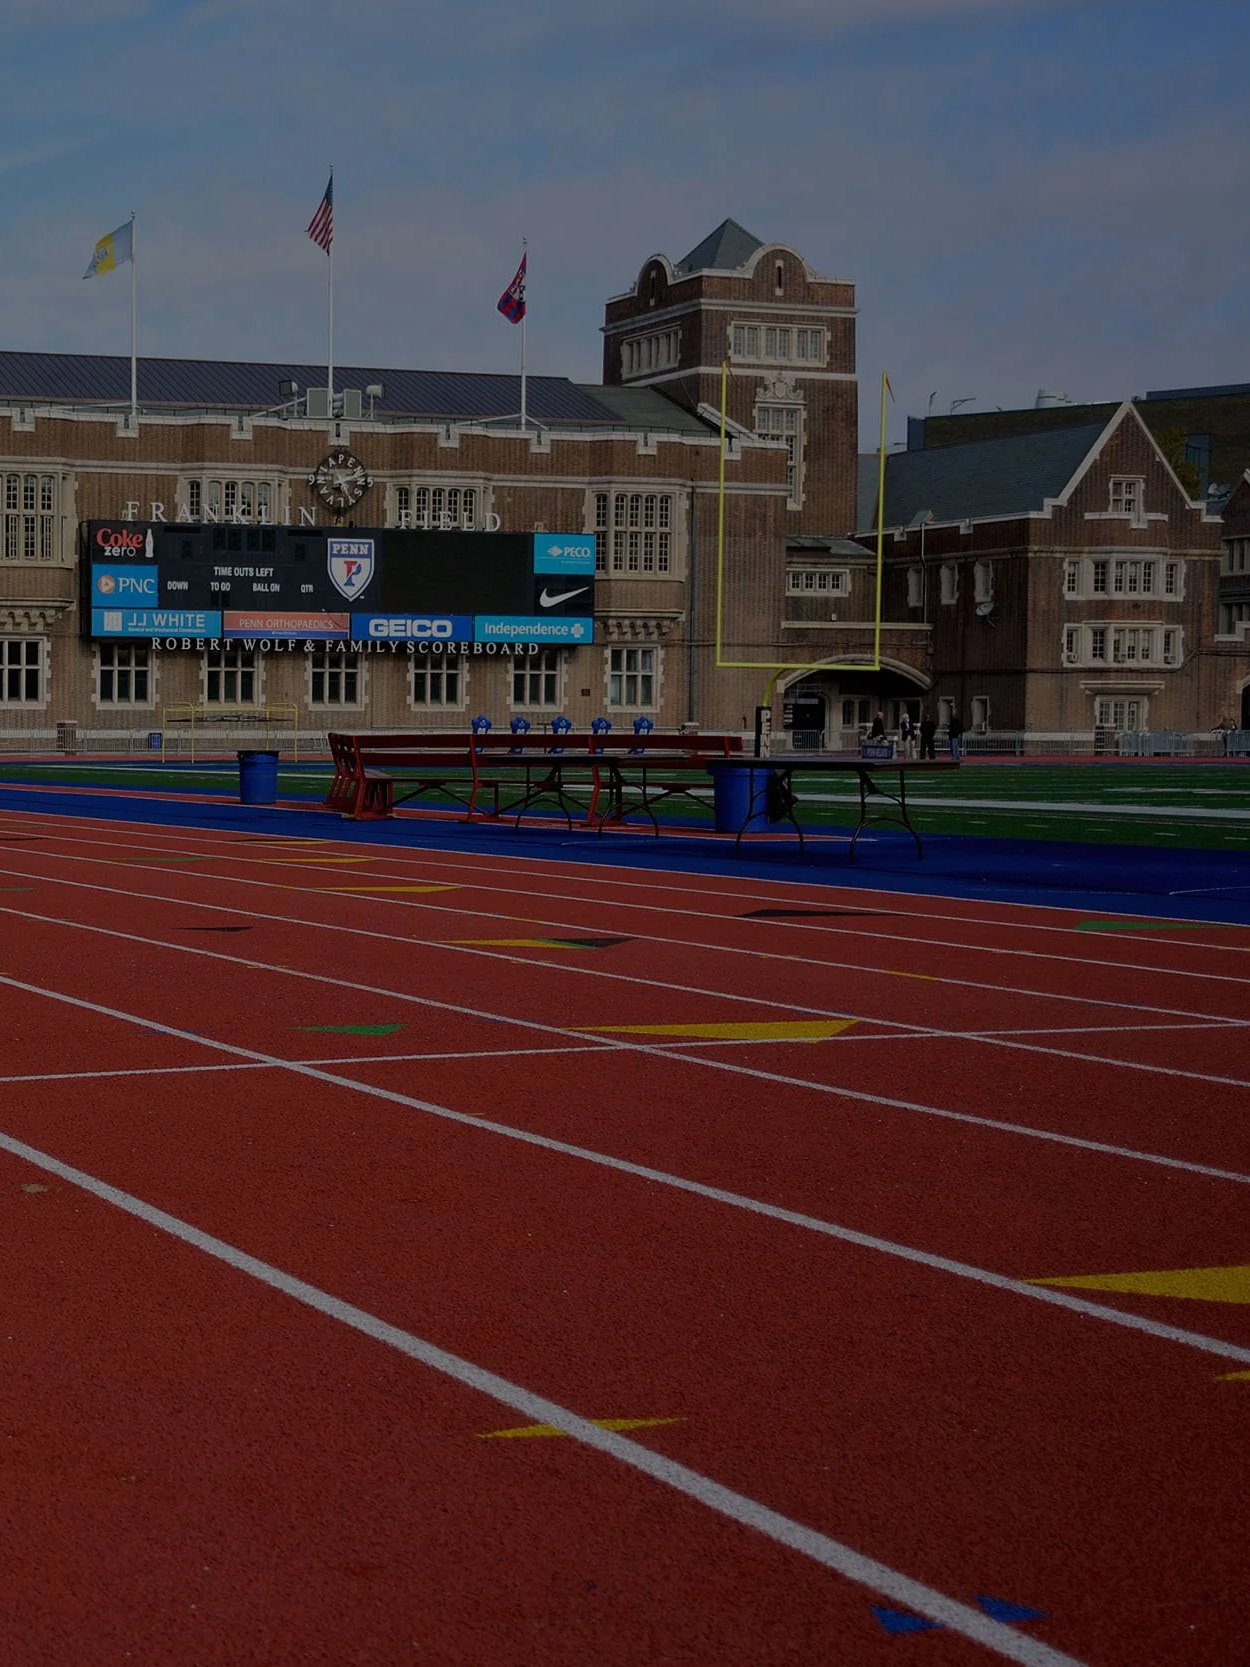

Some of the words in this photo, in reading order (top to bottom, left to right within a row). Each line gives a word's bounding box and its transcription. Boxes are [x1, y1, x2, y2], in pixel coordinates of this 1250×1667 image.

[125, 501, 317, 527] FRANKLIN
[400, 509, 501, 532] FIELD
[95, 527, 144, 547] Coke
[103, 546, 136, 557] zero
[332, 543, 369, 555] PENN
[564, 546, 591, 558] PECO
[213, 566, 232, 577] TIME
[233, 567, 254, 577] OUTS
[255, 567, 274, 578] LEFT
[117, 577, 156, 594] PNC
[167, 581, 189, 591] DOWN
[210, 582, 220, 592] TO
[220, 582, 231, 592] GO
[252, 583, 270, 593] BALL
[270, 584, 280, 593] ON
[300, 584, 314, 593] QTR
[152, 612, 206, 628] WHITE
[239, 618, 264, 629] PENN
[266, 619, 335, 630] ORTHOPAEDICS
[368, 618, 453, 639] GEICO
[484, 622, 568, 637] Independence
[151, 637, 233, 651] ROBERT
[243, 638, 297, 653] WOLF
[303, 640, 315, 653] &
[325, 640, 400, 654] FAMILY
[406, 641, 540, 656] SCOREBOARD
[760, 708, 771, 758] PENN
